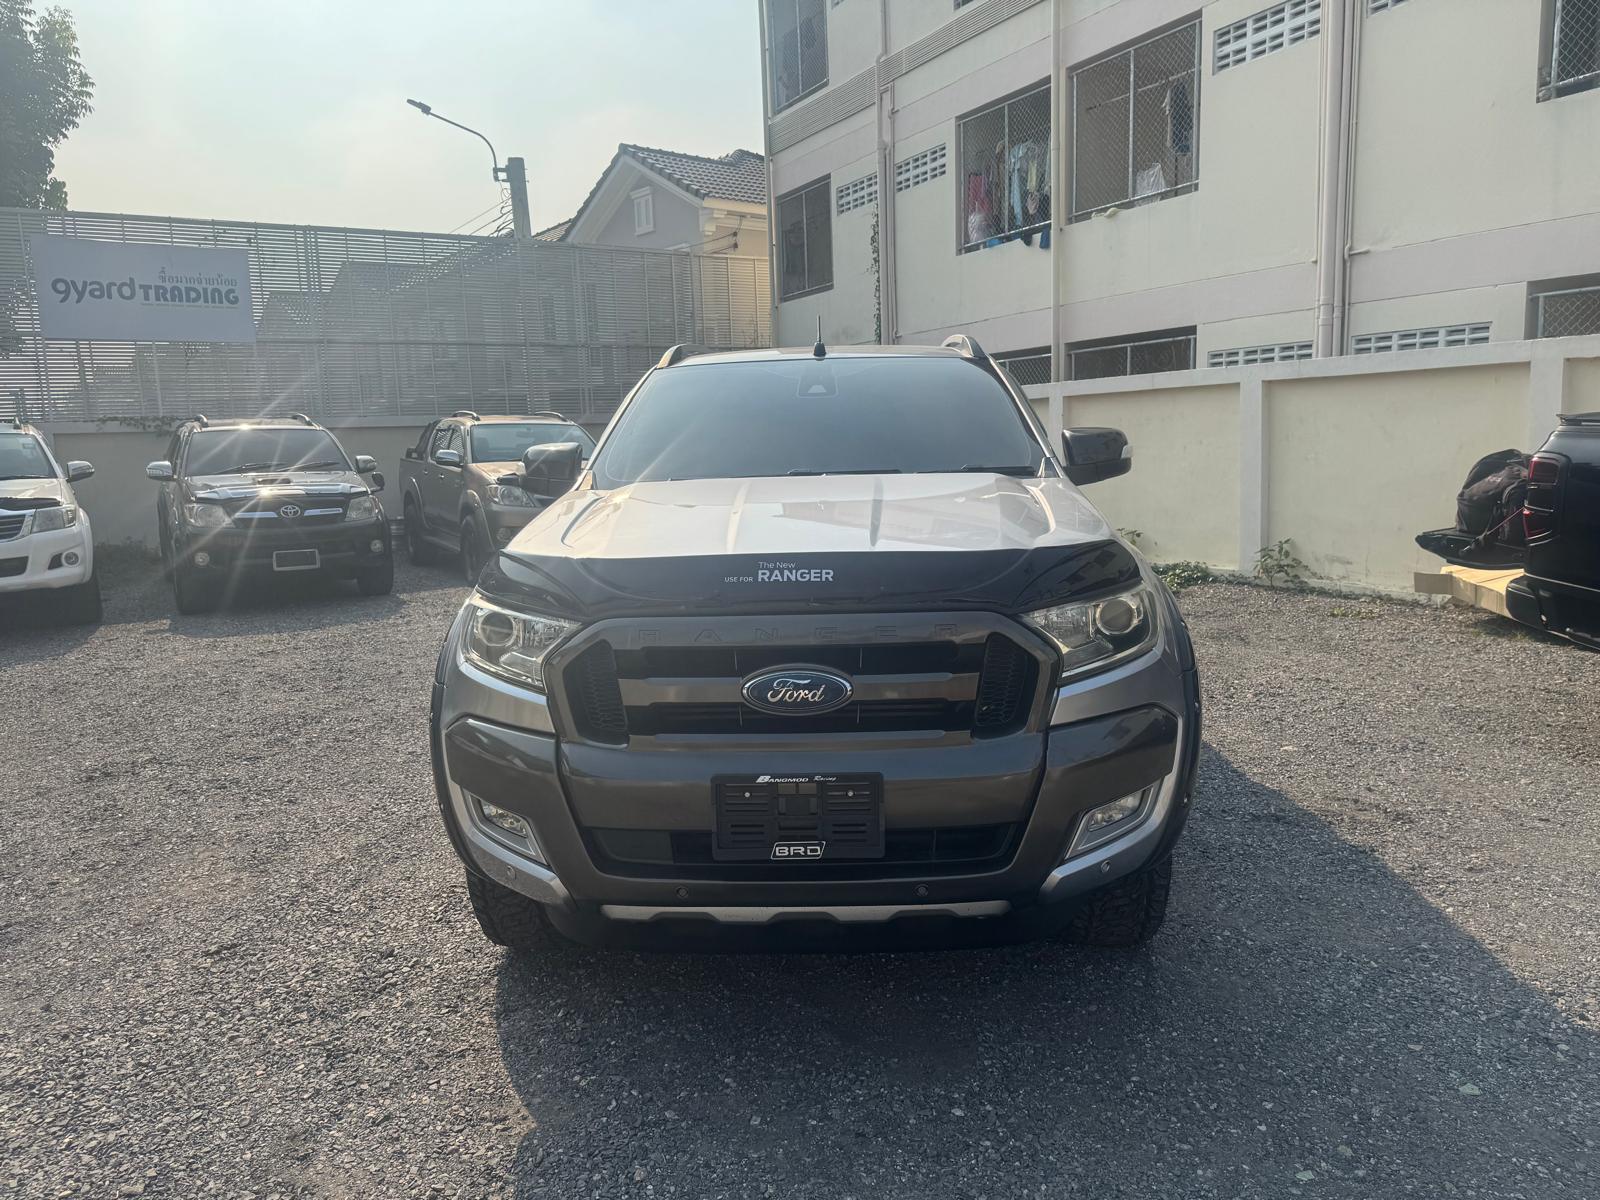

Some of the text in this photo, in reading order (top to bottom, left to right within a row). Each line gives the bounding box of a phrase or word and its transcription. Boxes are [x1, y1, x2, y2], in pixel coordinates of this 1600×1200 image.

[51, 276, 240, 306] 9yard TRADING
[758, 561, 797, 569] The New
[757, 569, 834, 582] RANGER
[766, 677, 826, 703] Ford
[775, 845, 821, 857] BRD
